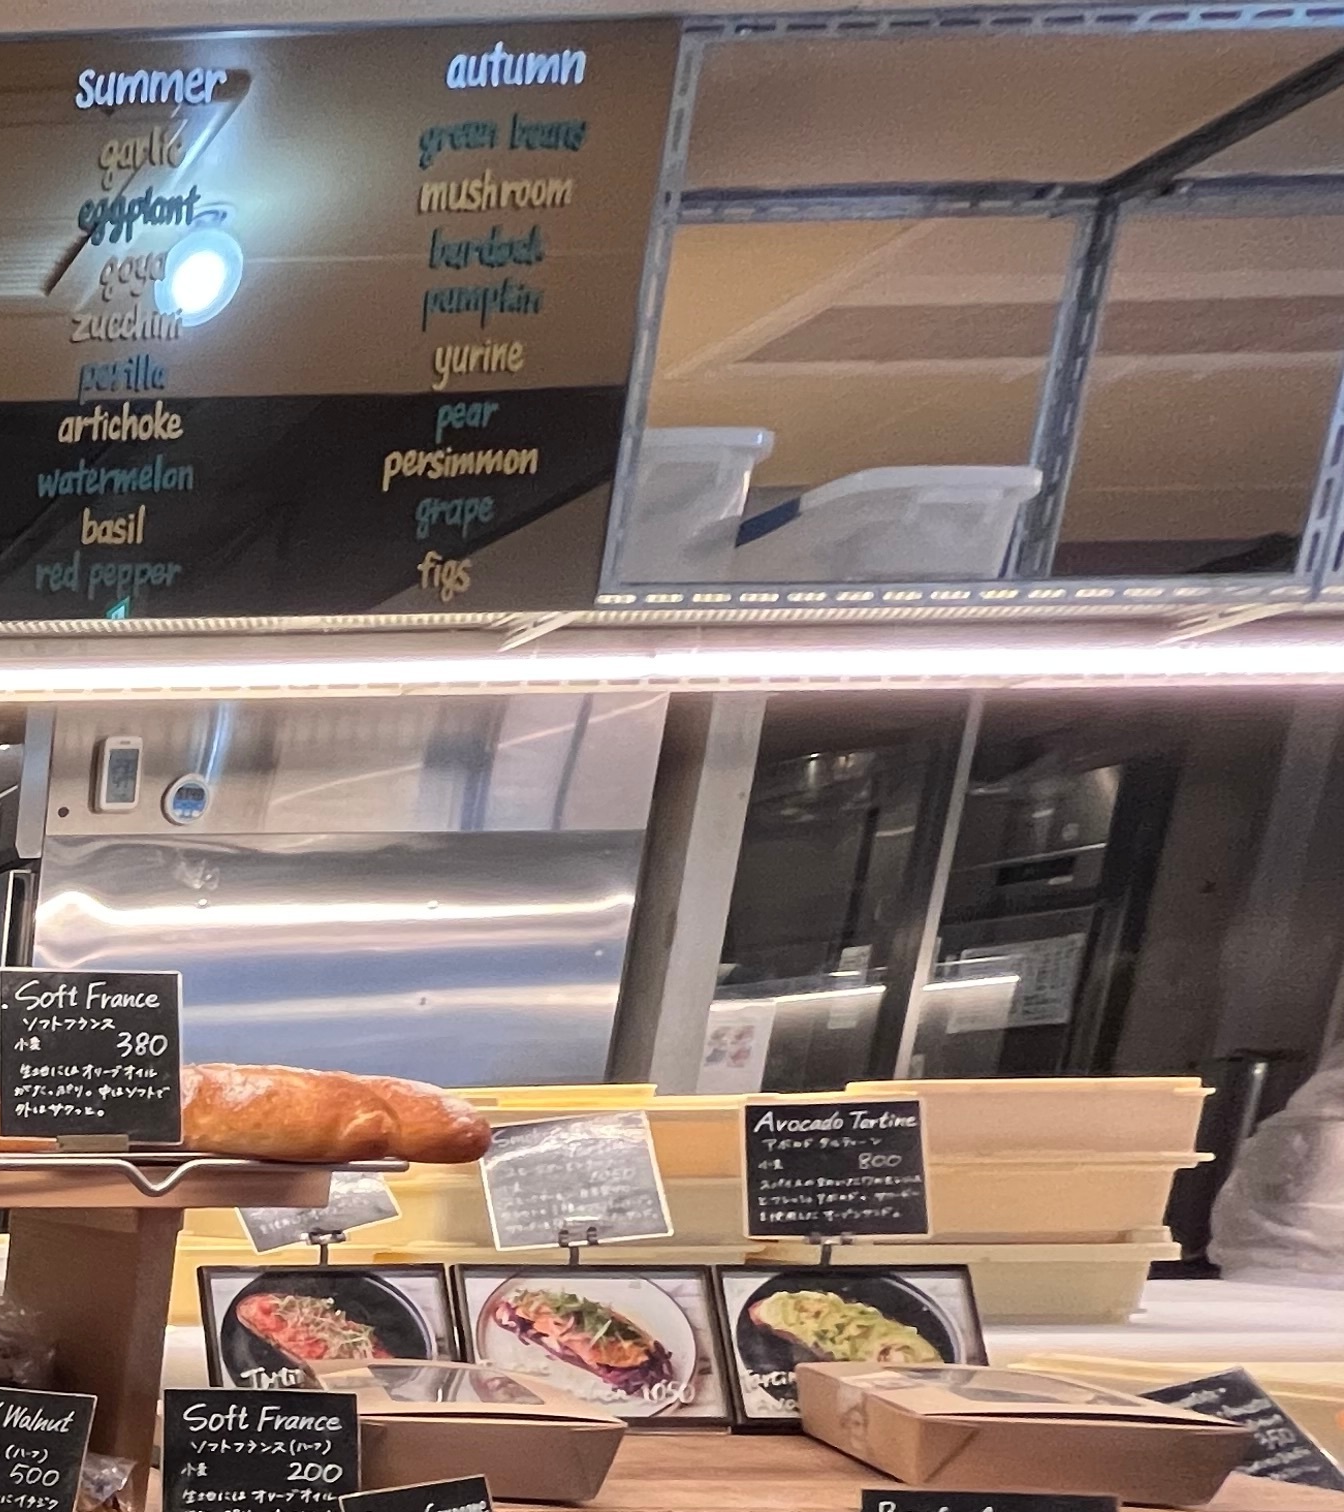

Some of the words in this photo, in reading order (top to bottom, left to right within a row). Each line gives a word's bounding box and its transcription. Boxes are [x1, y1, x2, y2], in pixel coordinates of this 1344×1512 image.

[446, 42, 587, 89] autumn
[75, 66, 228, 110] summer
[100, 121, 185, 190] garlic
[418, 168, 574, 215] mushroom
[77, 186, 201, 246] eggplant
[432, 337, 526, 390] yurine
[58, 402, 185, 443] artichoke
[436, 400, 500, 443] pear
[37, 452, 194, 497] watermelon
[383, 447, 539, 491] persimmon
[80, 506, 146, 545] basil
[416, 497, 496, 539] grape
[36, 557, 79, 592] red
[88, 561, 182, 600] pepper
[417, 552, 473, 602] figs
[15, 980, 78, 1010] Soft
[86, 981, 160, 1009] France
[116, 1031, 168, 1058] 380
[753, 1110, 844, 1133] Avocado
[849, 1110, 918, 1129] Tartine
[859, 1152, 902, 1170] 800
[3, 1404, 75, 1432] Walnut
[183, 1403, 249, 1432] Soft
[257, 1406, 343, 1432] France
[9, 1462, 60, 1487] 500
[287, 1462, 343, 1484] 200
